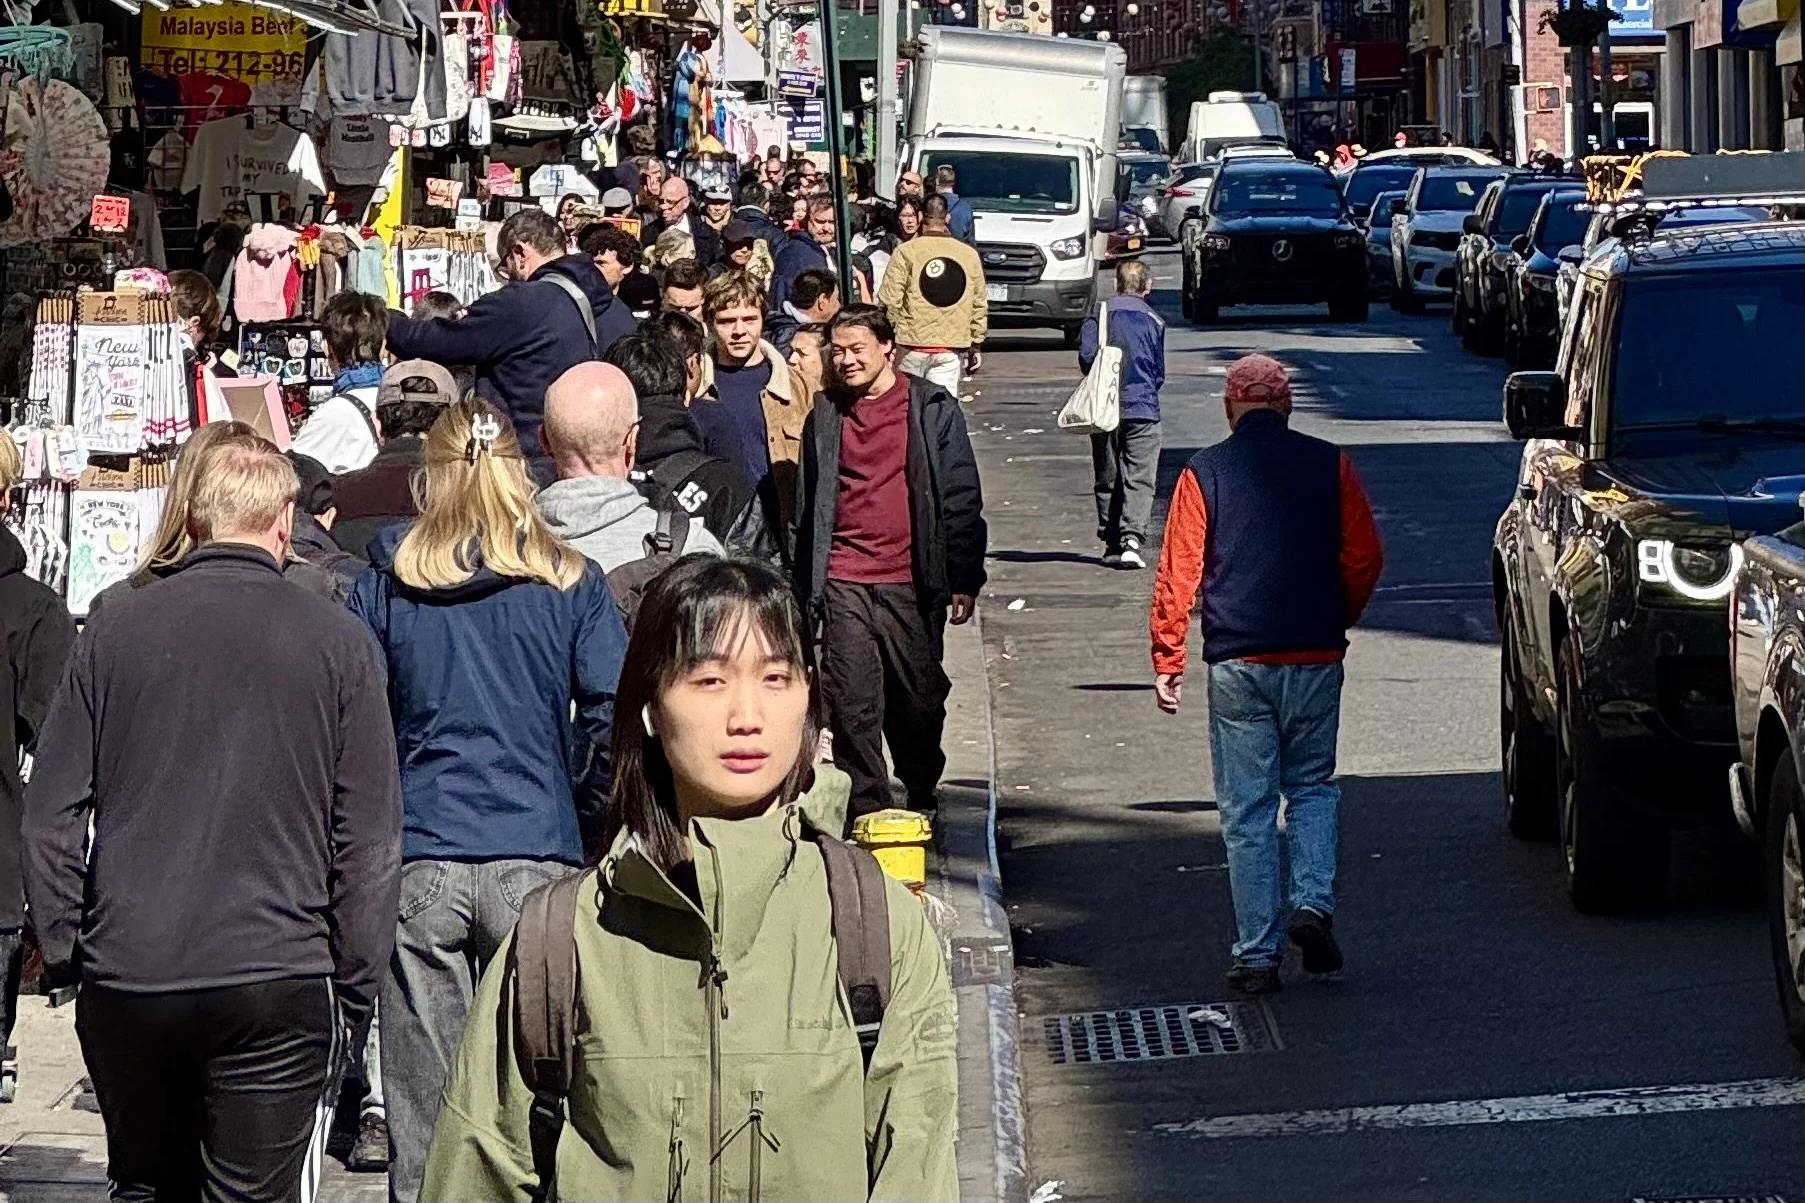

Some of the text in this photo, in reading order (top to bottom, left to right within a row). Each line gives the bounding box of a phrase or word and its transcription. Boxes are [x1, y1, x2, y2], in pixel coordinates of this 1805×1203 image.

[160, 15, 245, 39] Malaysia
[158, 49, 304, 76] Tel: 212-96
[234, 154, 290, 176] SURVIVED
[241, 173, 260, 185] MY
[95, 337, 140, 354] New
[106, 354, 141, 373] York
[677, 481, 708, 513] ES
